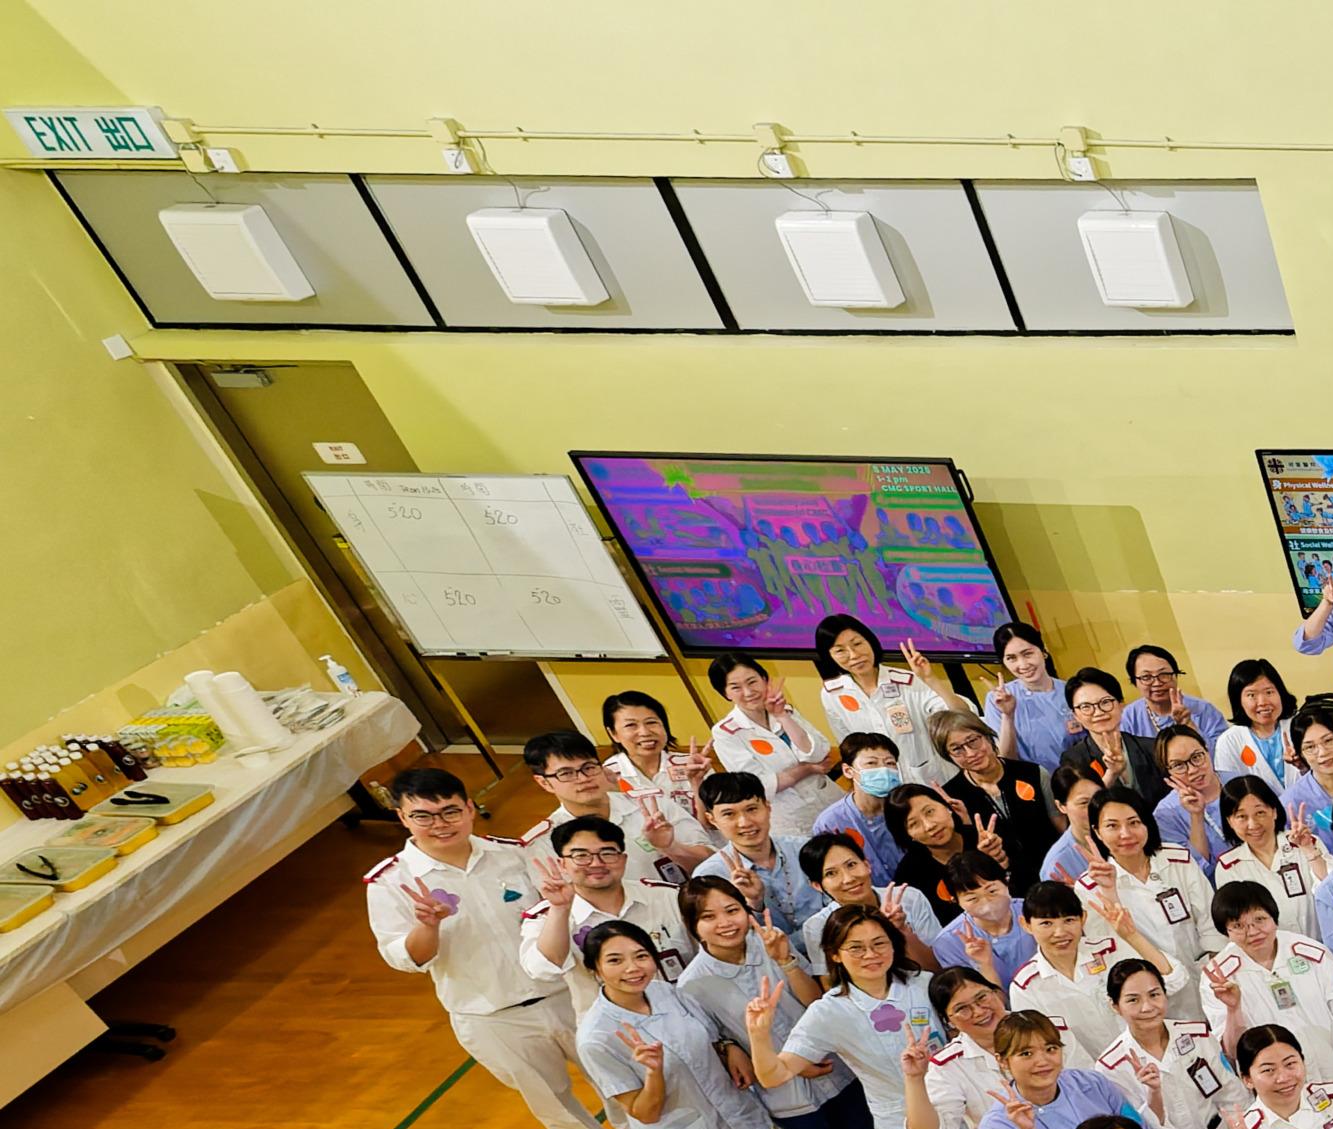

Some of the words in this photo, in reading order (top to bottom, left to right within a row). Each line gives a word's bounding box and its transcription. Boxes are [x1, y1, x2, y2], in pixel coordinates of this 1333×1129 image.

[23, 116, 93, 151] EXIT
[94, 116, 155, 151] 出口
[387, 503, 422, 520] 520
[484, 505, 519, 525] 520
[444, 588, 476, 606] 520
[531, 589, 561, 605] 520
